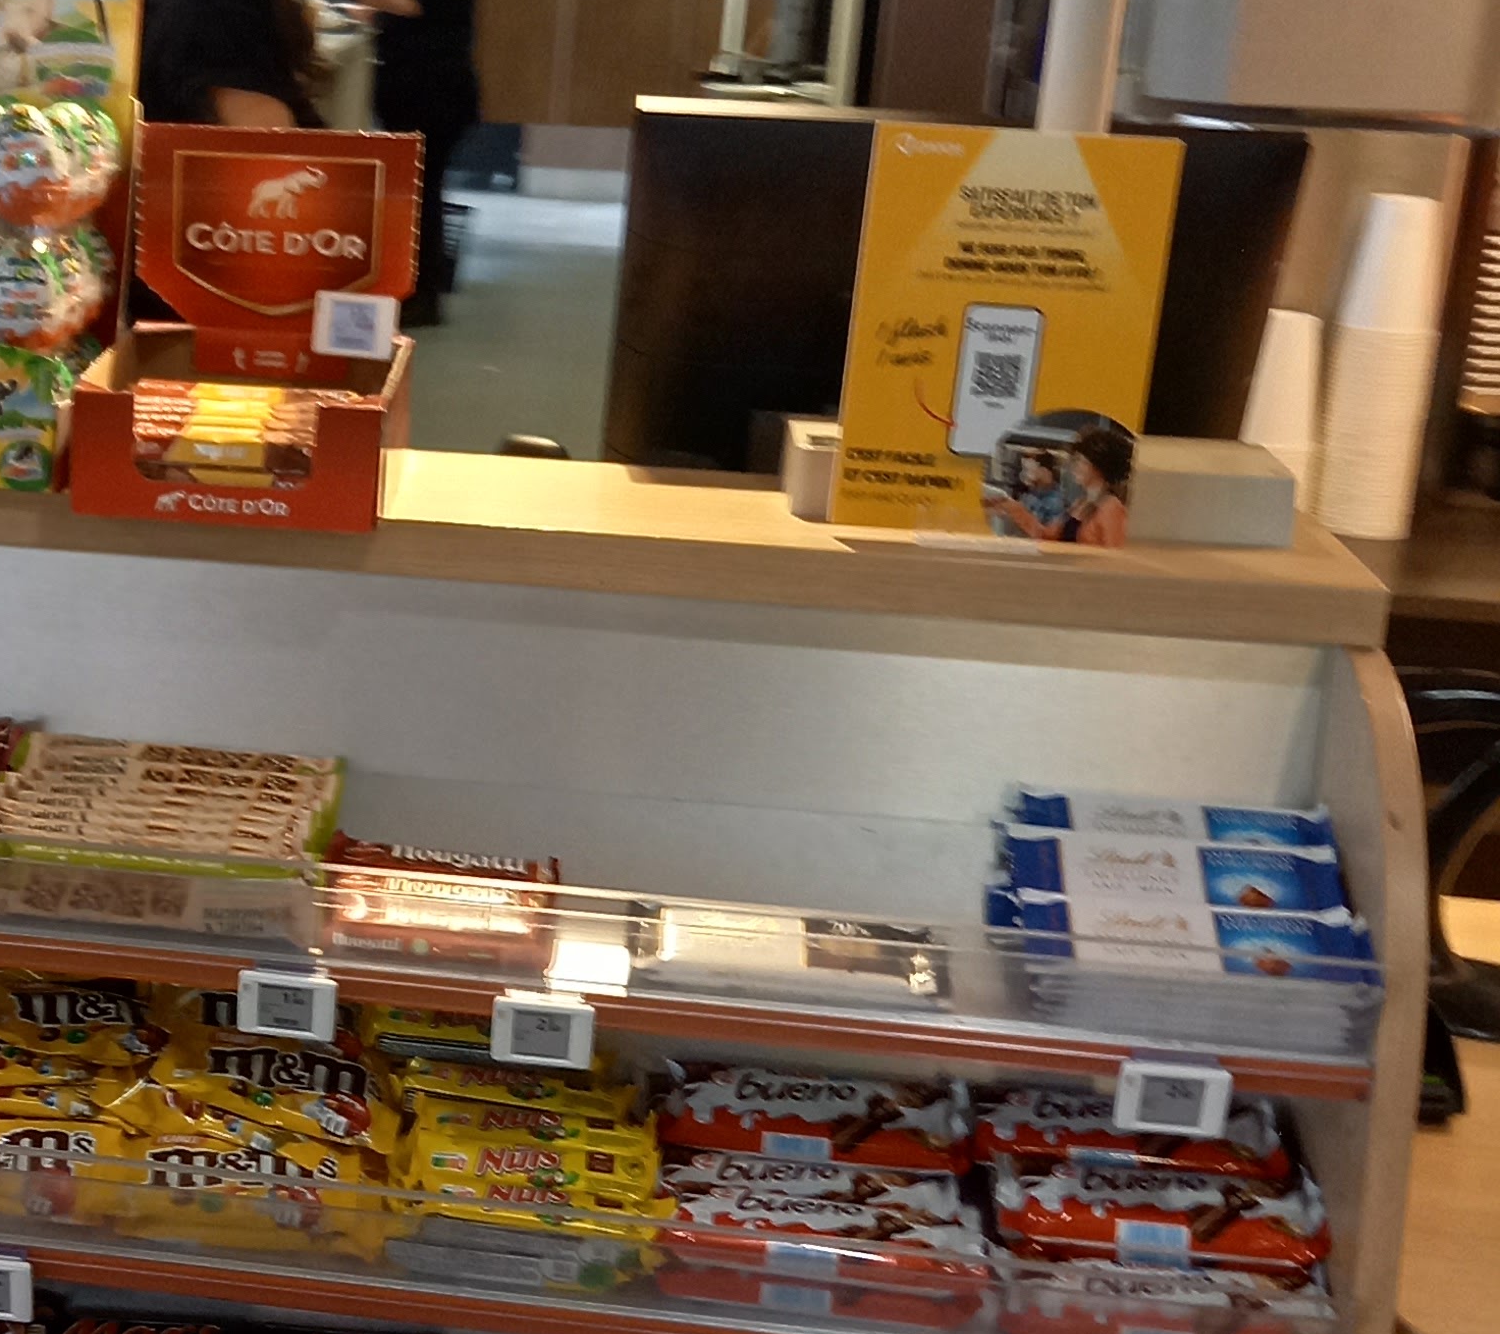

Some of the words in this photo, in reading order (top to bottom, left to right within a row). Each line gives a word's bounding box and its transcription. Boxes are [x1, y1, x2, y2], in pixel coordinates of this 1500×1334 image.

[185, 221, 276, 256] CÔTE
[282, 229, 368, 261] D'OR
[733, 1070, 859, 1102] bueno
[474, 1146, 562, 1177] NUTS
[734, 1191, 863, 1216] bueno
